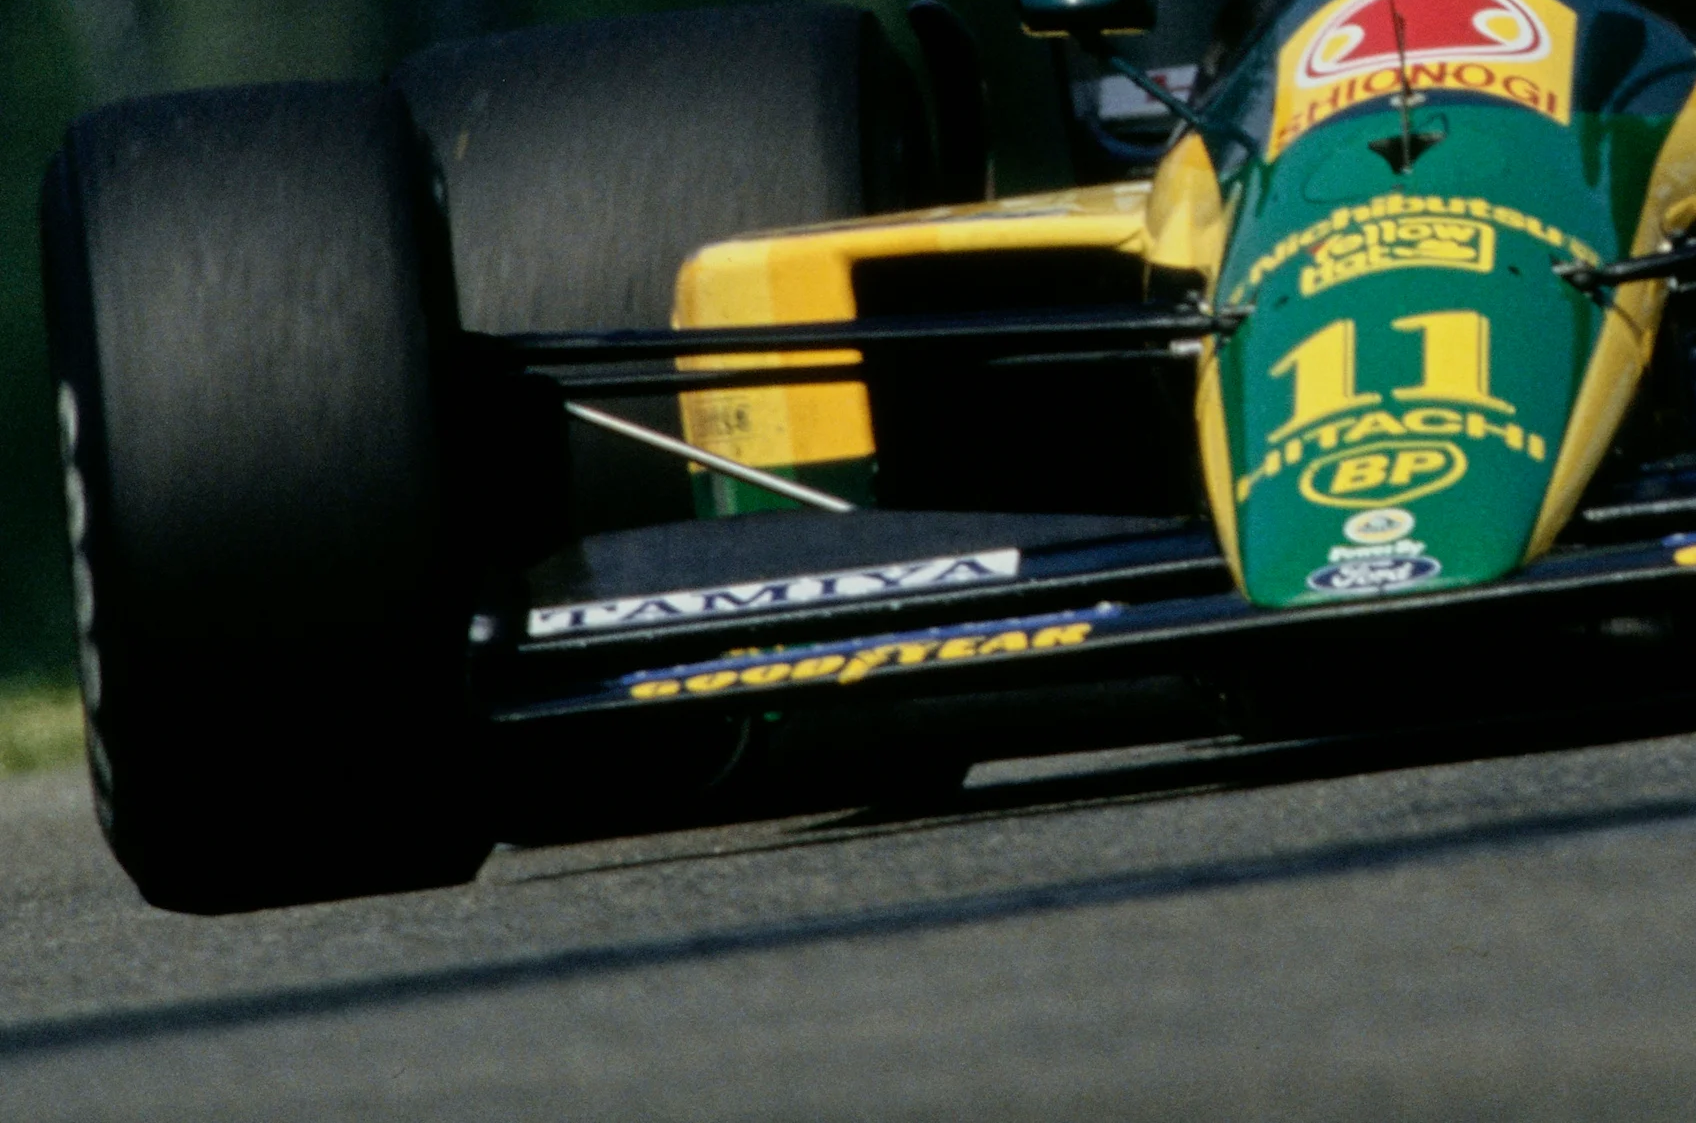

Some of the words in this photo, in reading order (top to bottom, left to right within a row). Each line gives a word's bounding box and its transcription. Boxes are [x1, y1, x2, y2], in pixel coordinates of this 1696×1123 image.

[1276, 62, 1558, 150] SHIONOGI
[1267, 309, 1517, 444] 11
[1236, 407, 1546, 503] HITACHI
[1329, 449, 1448, 496] BP
[540, 558, 997, 629] TAMIYA
[629, 622, 1093, 701] GOODYEAR
